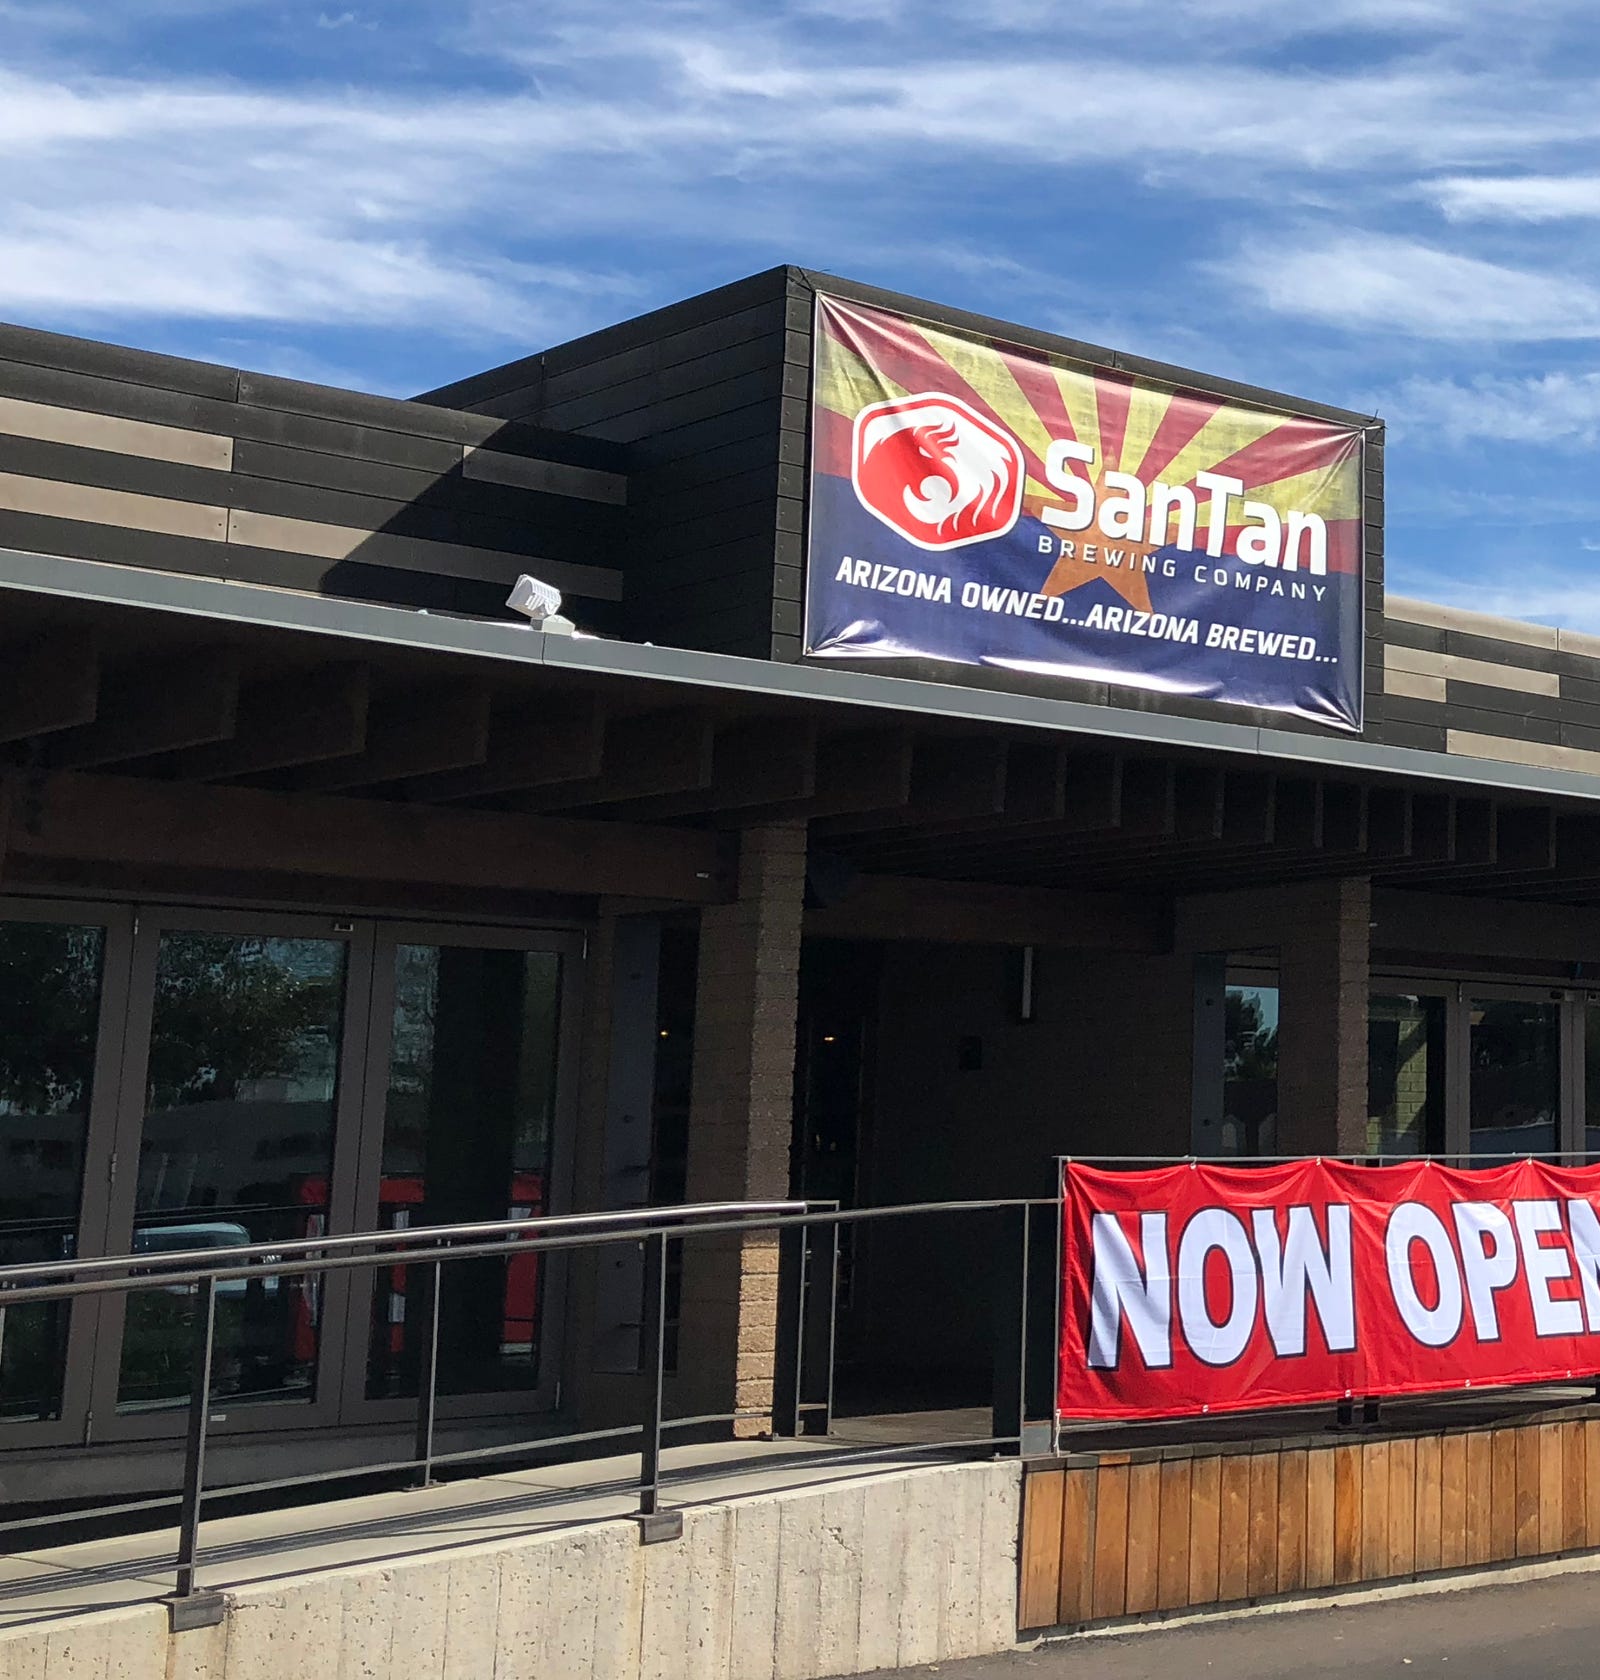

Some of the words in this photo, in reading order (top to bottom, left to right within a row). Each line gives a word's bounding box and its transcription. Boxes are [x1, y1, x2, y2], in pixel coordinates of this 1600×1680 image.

[1041, 438, 1329, 576] SanTan
[835, 556, 951, 604] ARIZONA
[1205, 623, 1339, 663] BREWED...
[1038, 535, 1177, 578] BREWING
[1194, 565, 1327, 602] COMPANY
[1086, 1202, 1358, 1371] NOW
